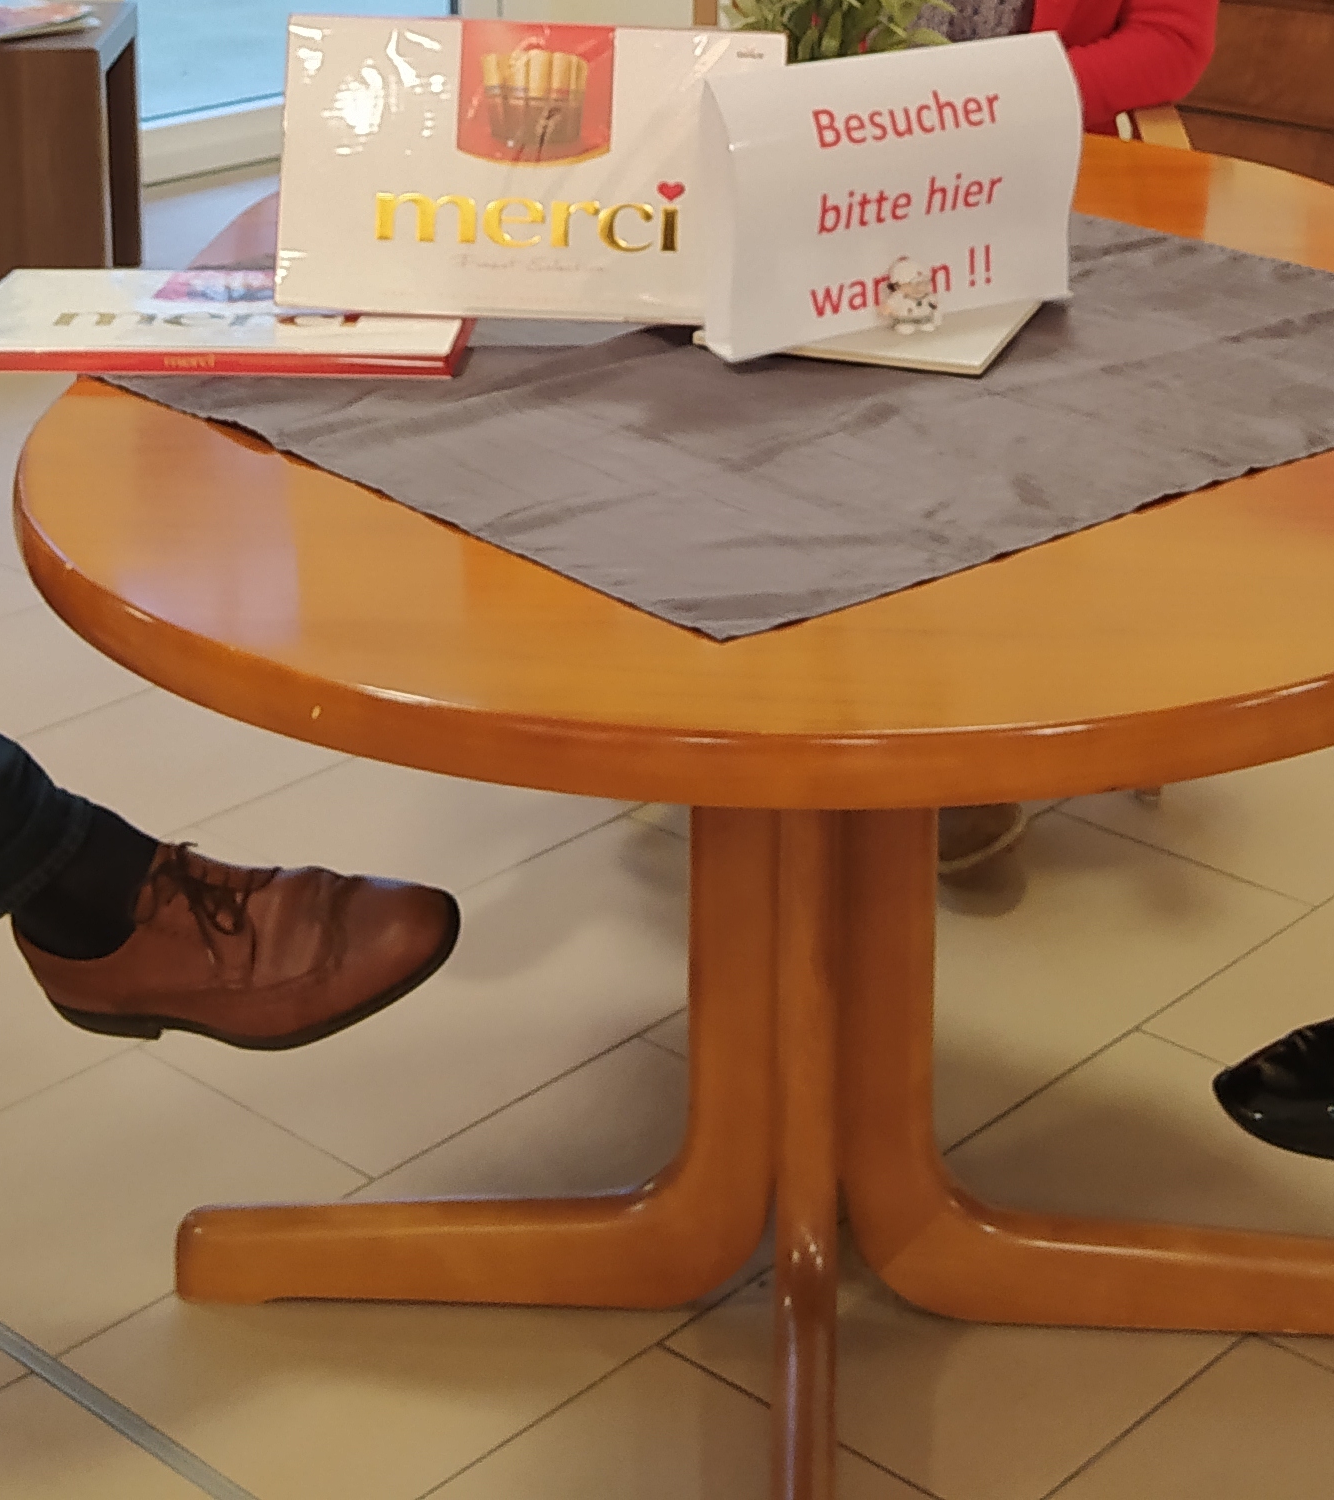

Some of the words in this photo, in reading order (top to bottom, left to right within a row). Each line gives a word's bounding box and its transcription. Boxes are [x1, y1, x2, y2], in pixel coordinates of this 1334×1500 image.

[811, 89, 1000, 150] Besucher
[373, 181, 685, 253] merci
[817, 189, 913, 235] bitte
[924, 172, 1004, 216] hier
[810, 262, 952, 318] warn
[967, 244, 993, 288] !!
